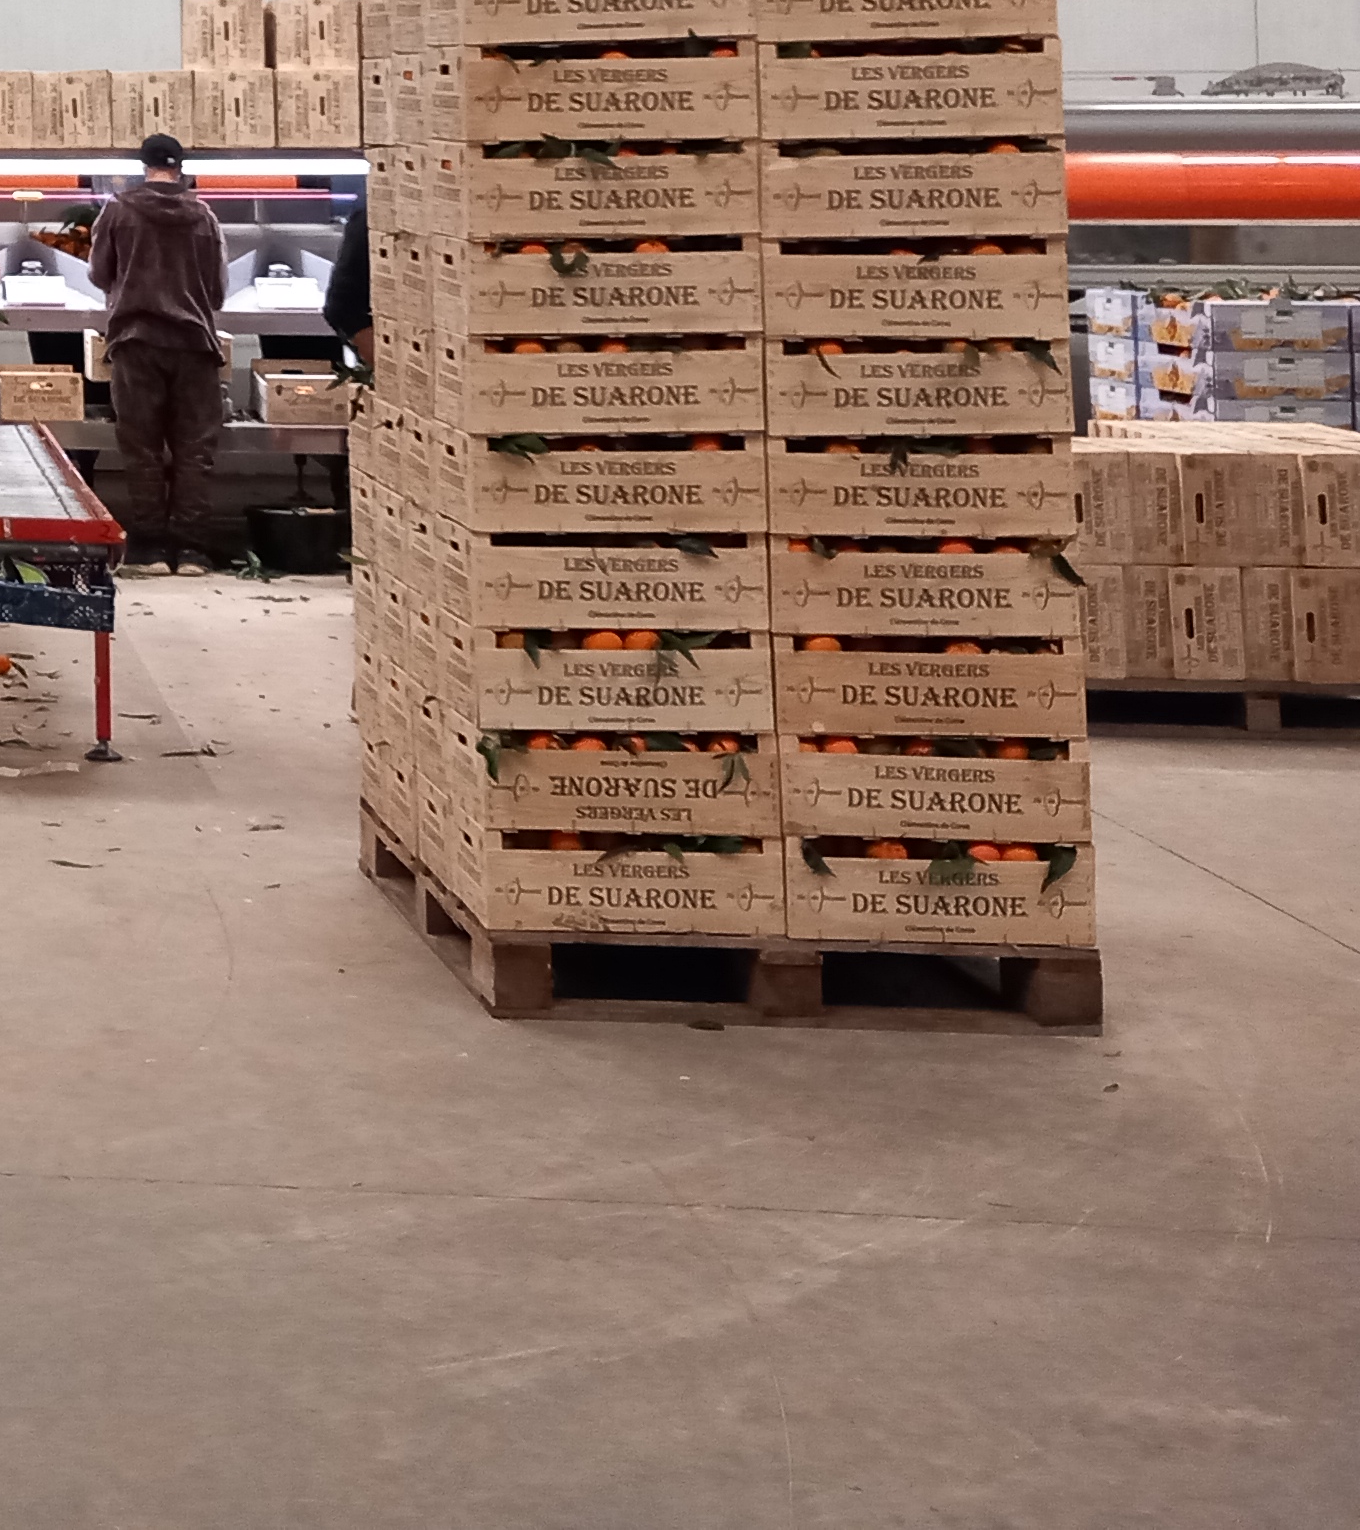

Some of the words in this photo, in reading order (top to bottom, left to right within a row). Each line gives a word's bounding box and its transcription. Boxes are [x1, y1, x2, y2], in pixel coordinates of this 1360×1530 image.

[528, 91, 564, 112] DE
[569, 91, 694, 112] SUARONE
[824, 88, 859, 110] DE
[867, 88, 998, 110] SUARONE
[827, 188, 863, 210] DE
[869, 188, 1002, 210] SUARONE
[530, 286, 566, 307] DE
[570, 286, 699, 307] SUARONE
[531, 385, 567, 407] DE
[573, 385, 700, 407] SUARONE
[834, 387, 870, 408] DE
[877, 387, 1009, 408] SUARONE
[534, 485, 570, 505] DE
[576, 485, 704, 505] SUARONE
[834, 486, 869, 508] DE
[875, 486, 1007, 508] SUARONE
[538, 581, 573, 601] DE
[579, 581, 705, 601] SUARONE
[837, 588, 873, 608] DE
[880, 588, 1012, 608] SUARONE
[842, 685, 877, 707] DE
[884, 685, 1018, 707] SUARONE
[548, 887, 583, 909] DE
[589, 887, 716, 909] SUARONE
[853, 894, 888, 916] DE
[896, 894, 1028, 916] SUARONE
